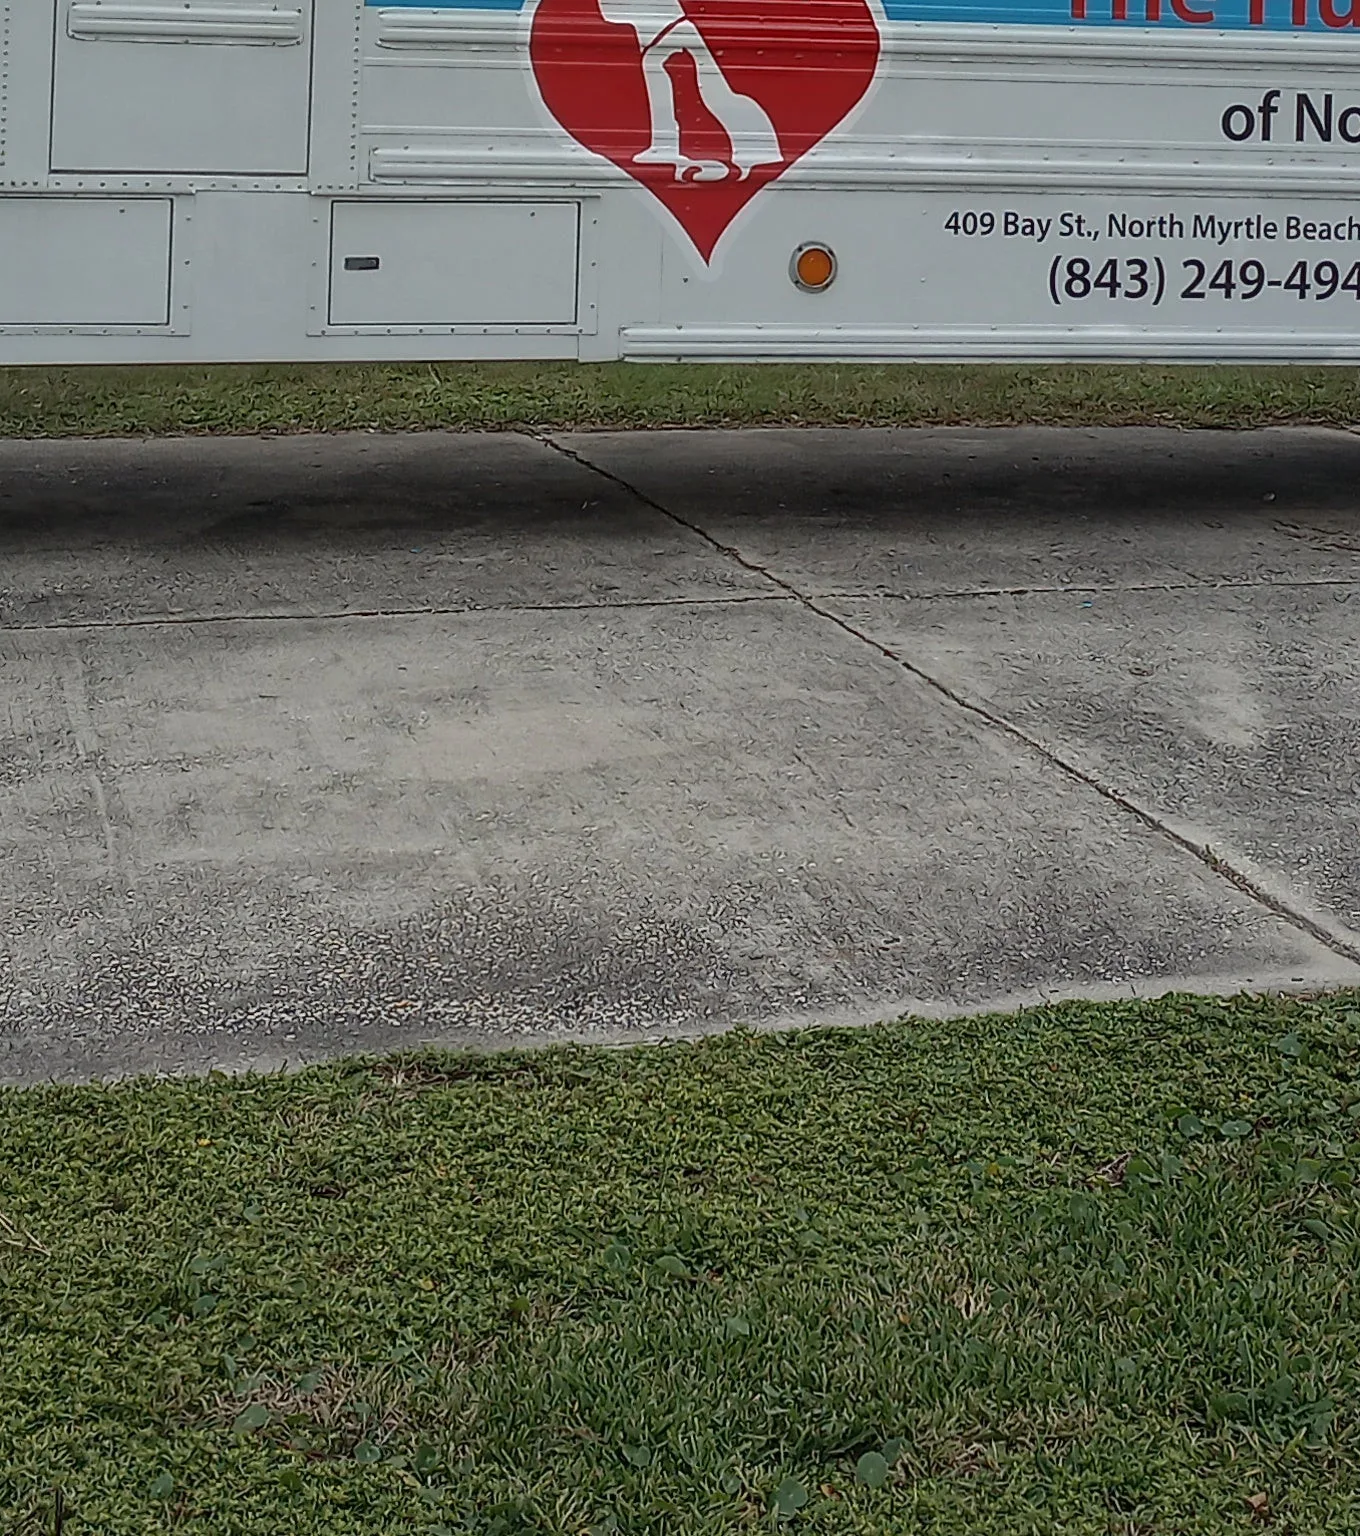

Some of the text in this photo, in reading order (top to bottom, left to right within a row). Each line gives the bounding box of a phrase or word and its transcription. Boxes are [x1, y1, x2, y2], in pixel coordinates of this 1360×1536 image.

[1220, 90, 1274, 142] of
[944, 211, 995, 236] 409
[1003, 211, 1053, 243] Bay
[1059, 212, 1100, 242] St.,
[1108, 213, 1184, 239] North
[1192, 214, 1278, 246] Myrtle
[1049, 255, 1165, 306] (843)
